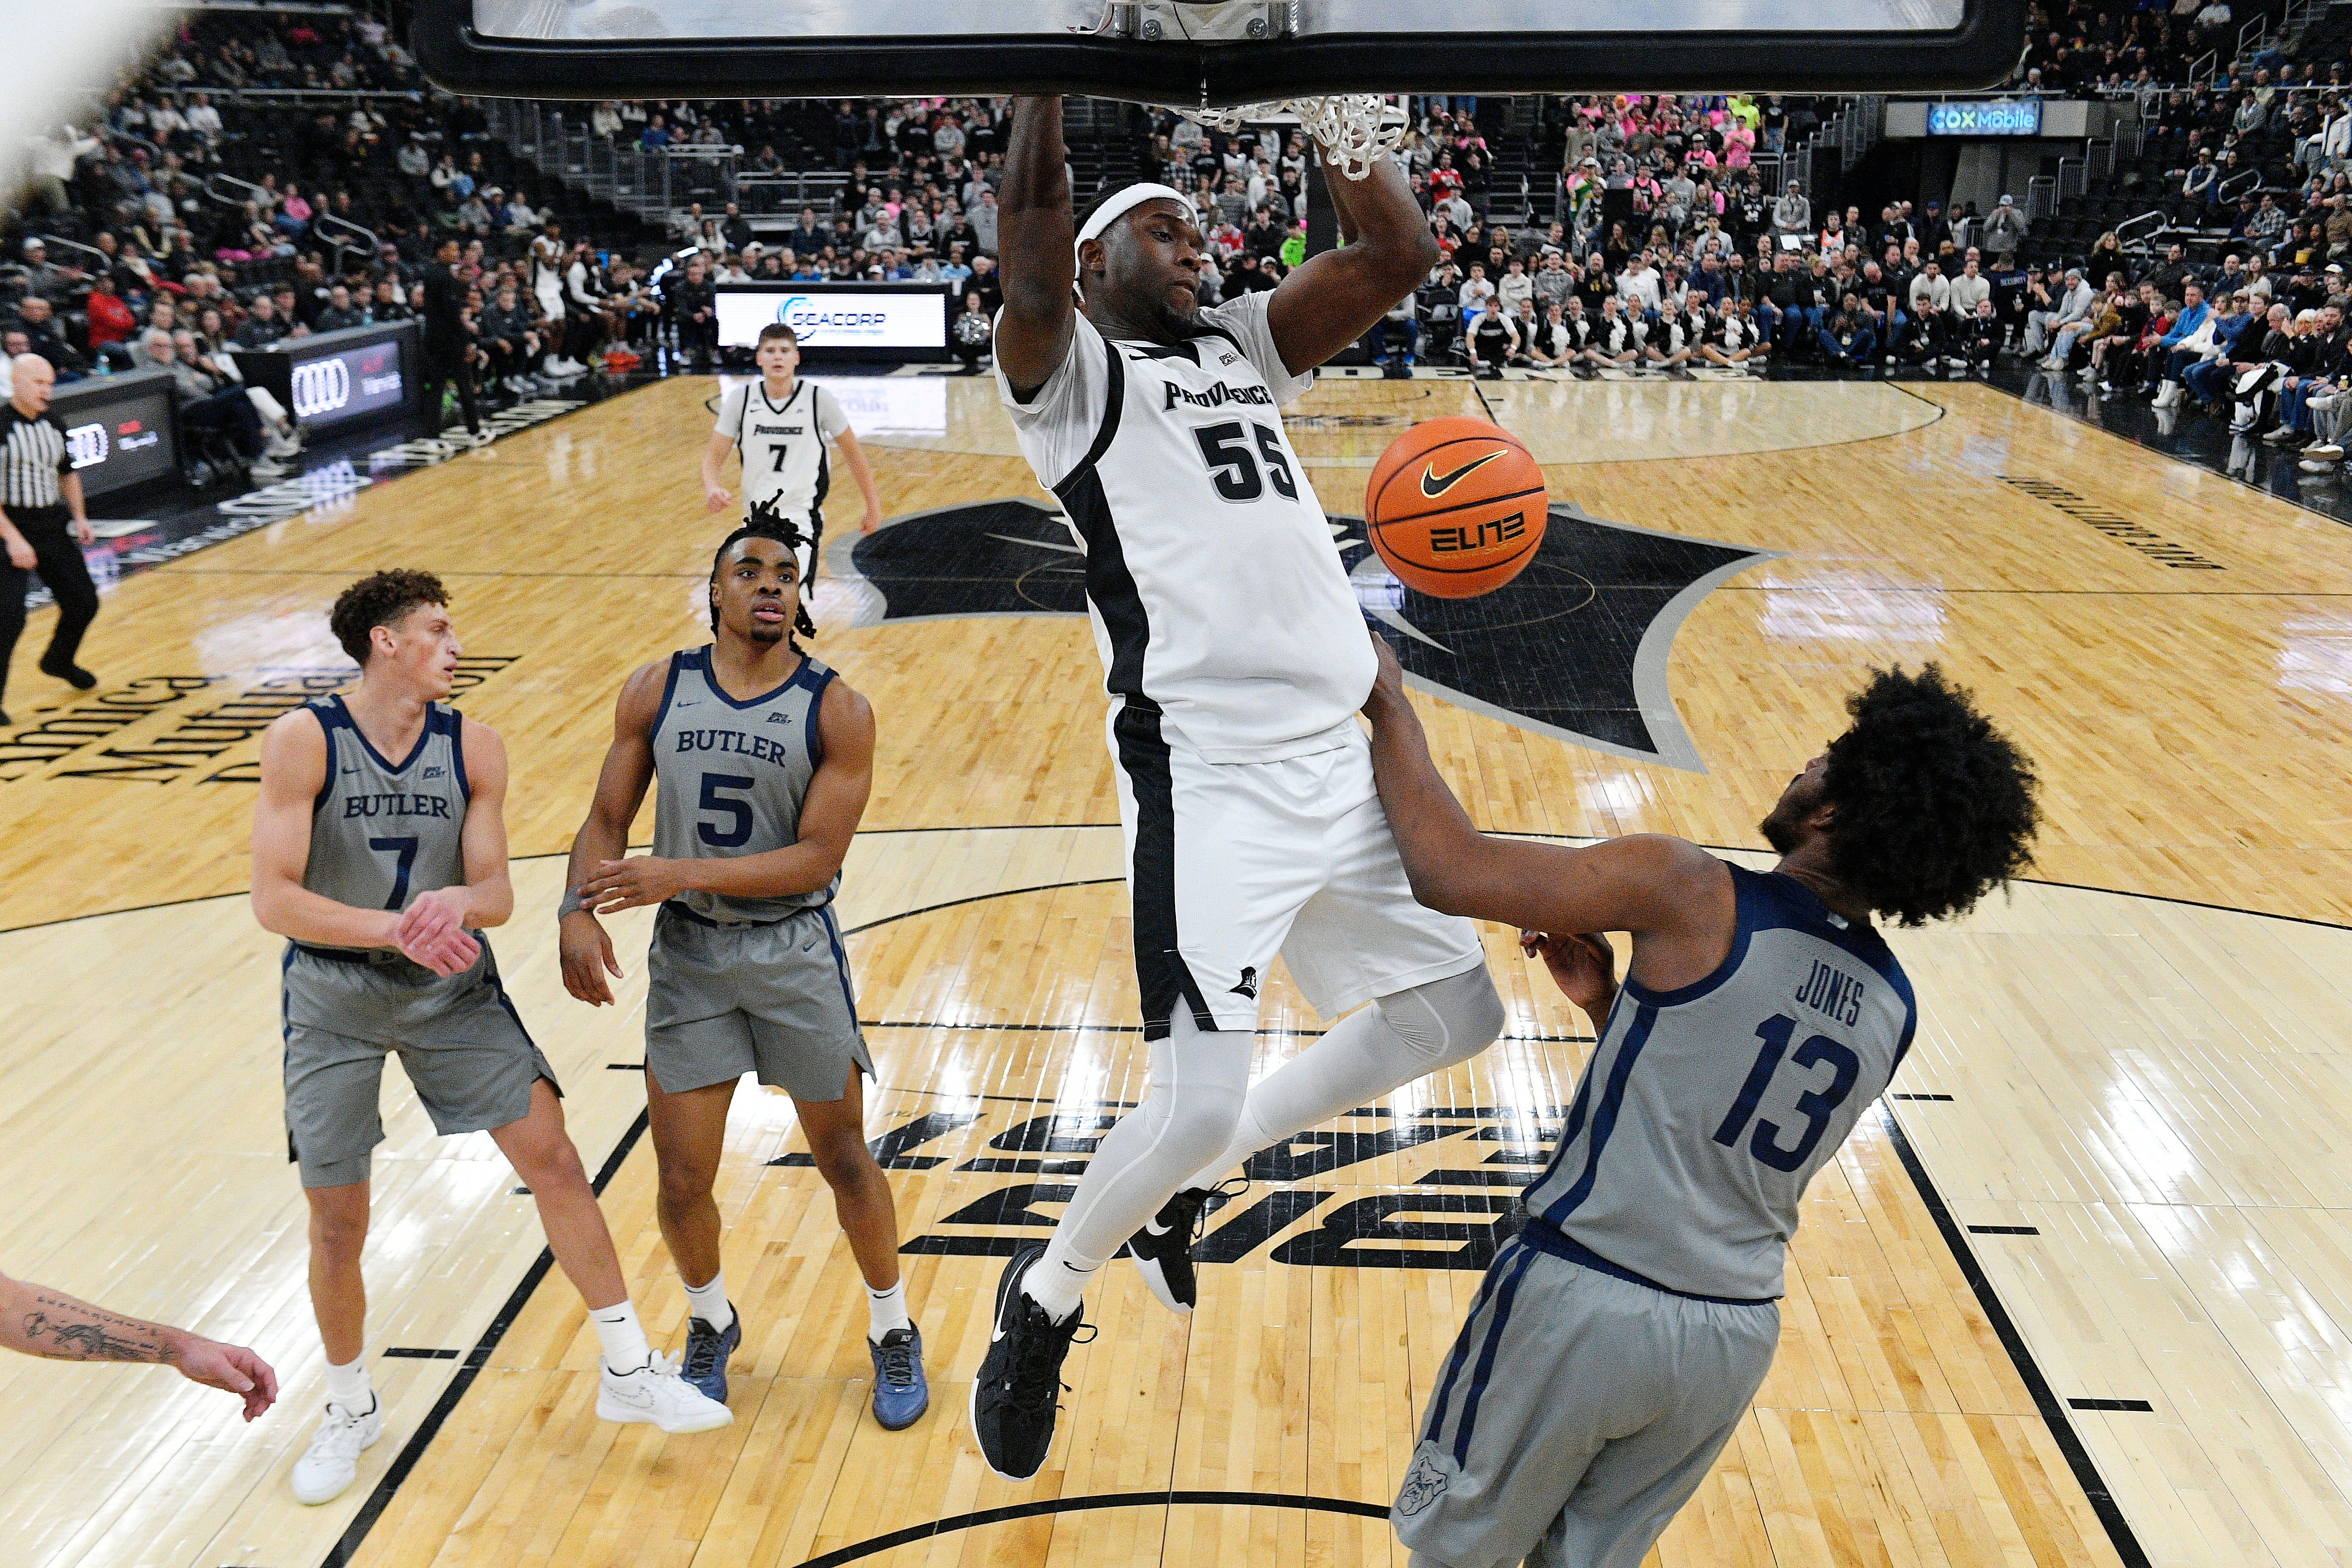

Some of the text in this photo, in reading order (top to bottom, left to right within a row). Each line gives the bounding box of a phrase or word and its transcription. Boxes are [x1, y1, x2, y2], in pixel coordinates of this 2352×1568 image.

[1933, 109, 2035, 129] COX Mobile
[793, 313, 886, 326] SEACORP
[1219, 353, 1231, 361] BIG
[1222, 356, 1239, 367] EAS
[1162, 380, 1275, 412] PROVIENCE
[769, 444, 787, 472] 7
[1190, 419, 1300, 504] 55
[1430, 511, 1525, 552] ELITE
[676, 730, 785, 768] BUTLER
[344, 793, 450, 819] BUTLER
[697, 773, 754, 847] 5
[370, 838, 418, 911] 7
[1796, 960, 1864, 1027] JONES
[1713, 1013, 1860, 1173] 13
